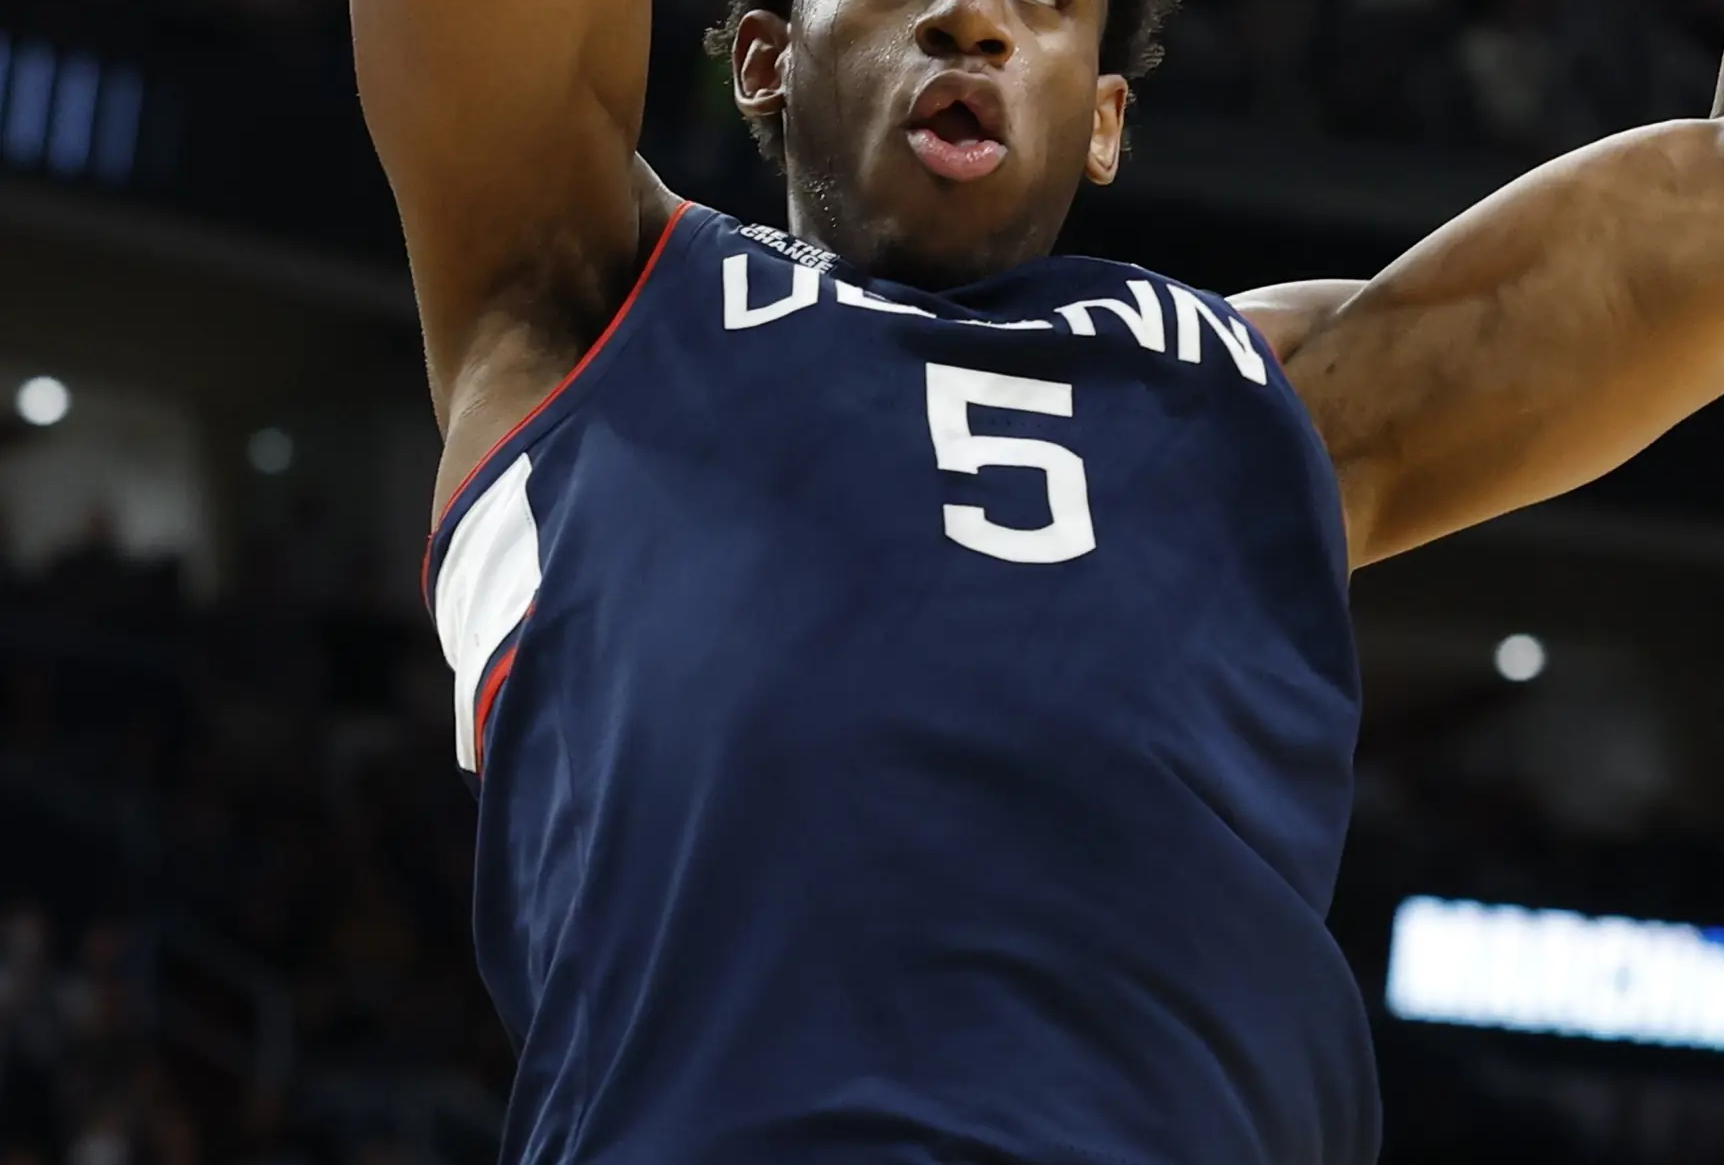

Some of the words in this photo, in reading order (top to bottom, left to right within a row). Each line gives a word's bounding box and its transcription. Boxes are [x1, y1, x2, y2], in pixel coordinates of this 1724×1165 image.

[740, 226, 834, 275] CHANGE
[793, 238, 837, 263] THE
[723, 253, 1267, 386] UNN
[926, 362, 1097, 564] 5
